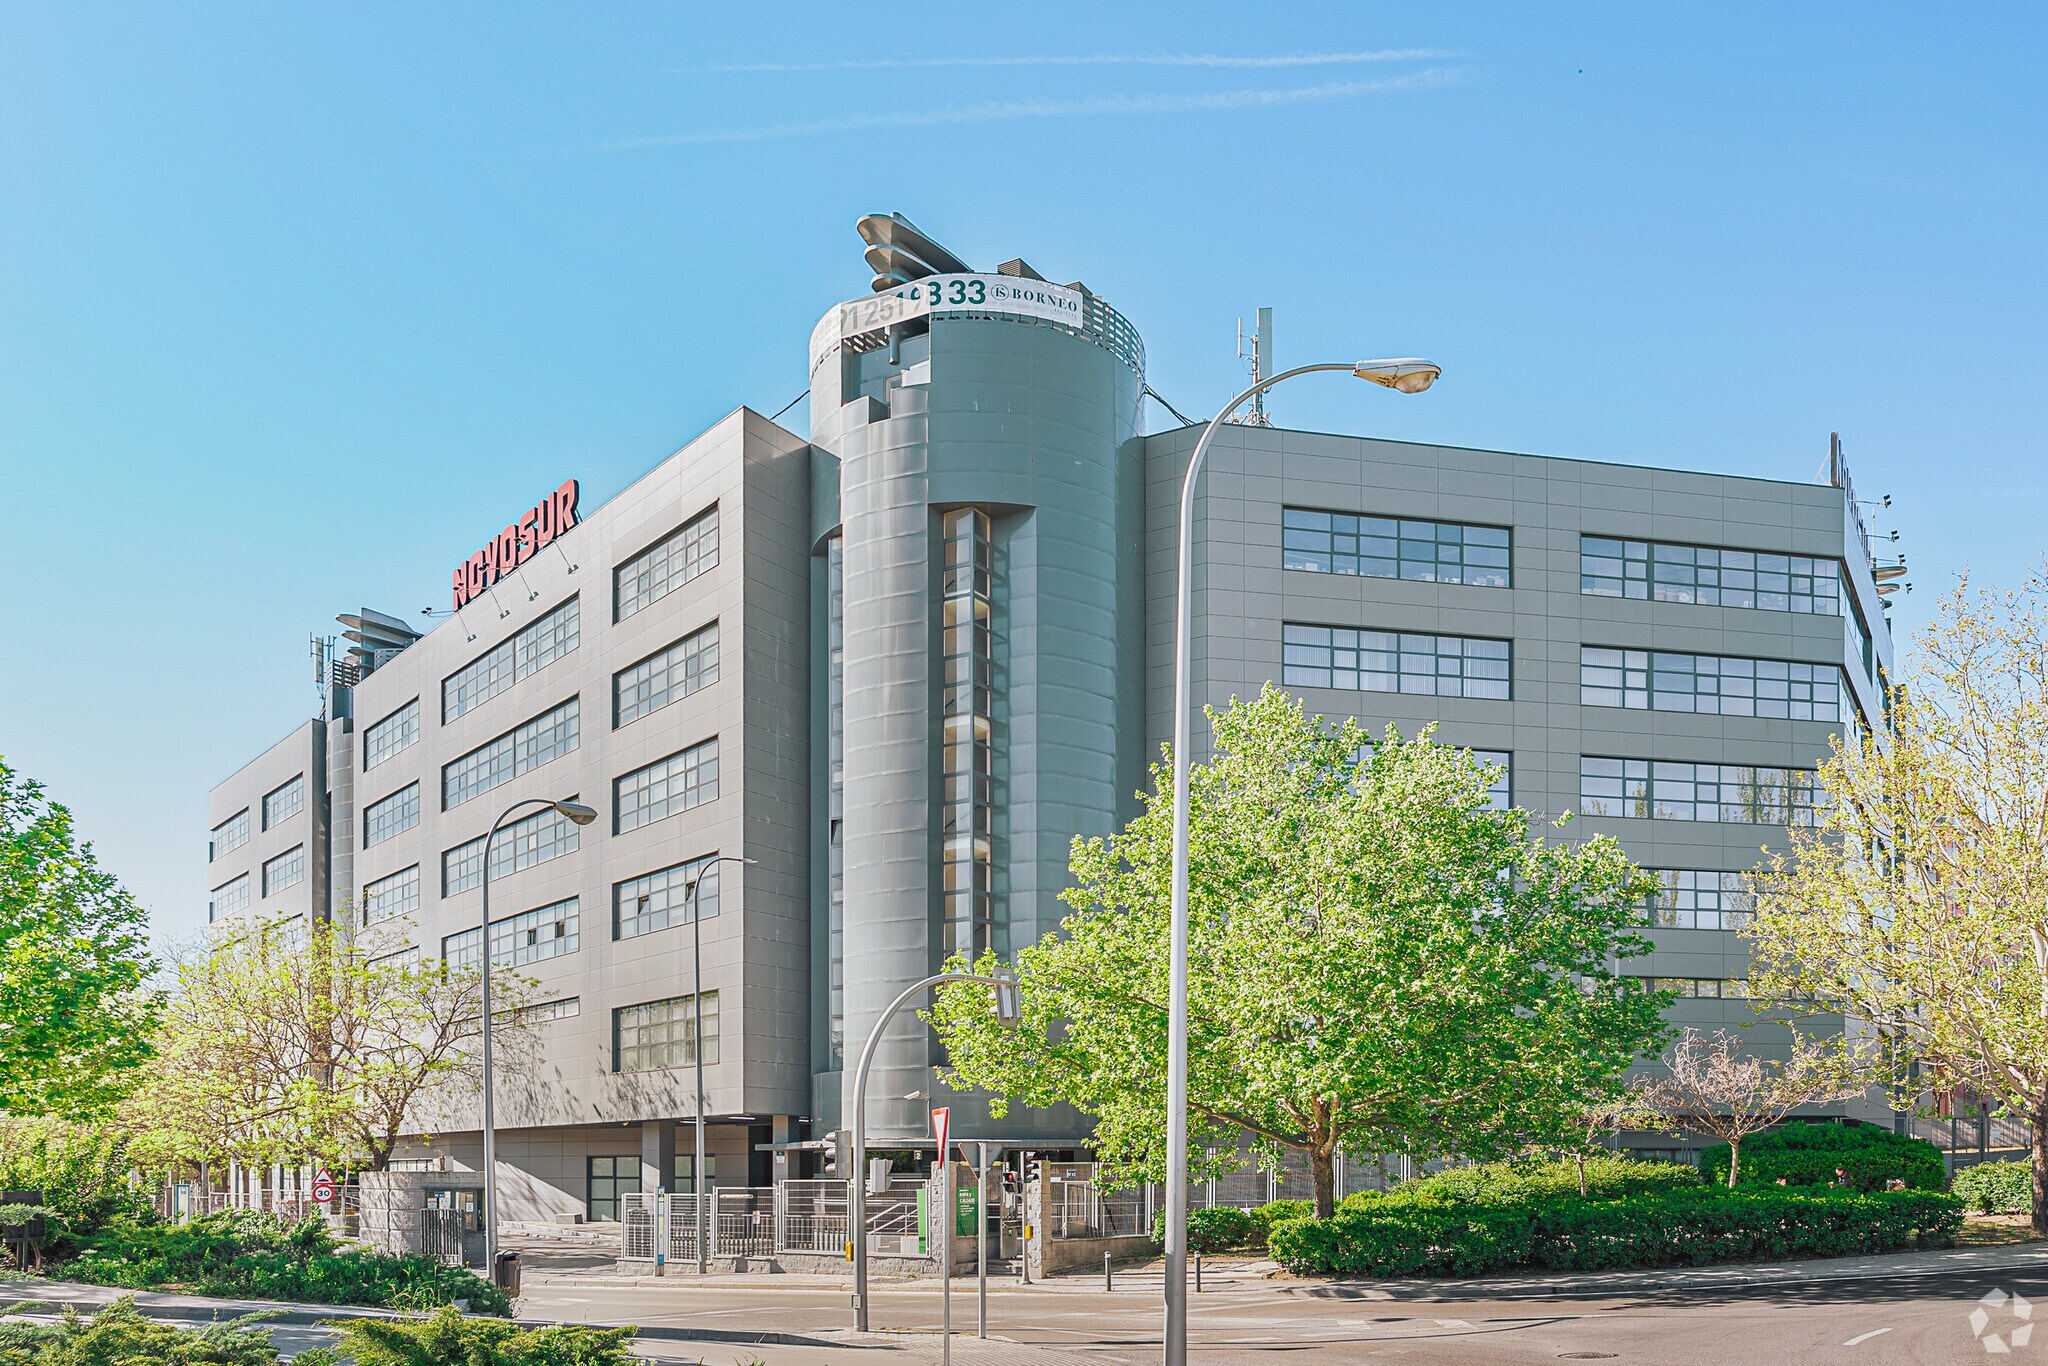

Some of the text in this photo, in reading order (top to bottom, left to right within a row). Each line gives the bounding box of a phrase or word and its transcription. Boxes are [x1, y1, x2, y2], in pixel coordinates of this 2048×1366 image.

[948, 279, 986, 305] 33
[1012, 288, 1077, 312] BORNEO
[452, 478, 580, 612] NOVOSUR
[317, 1189, 330, 1197] 30
